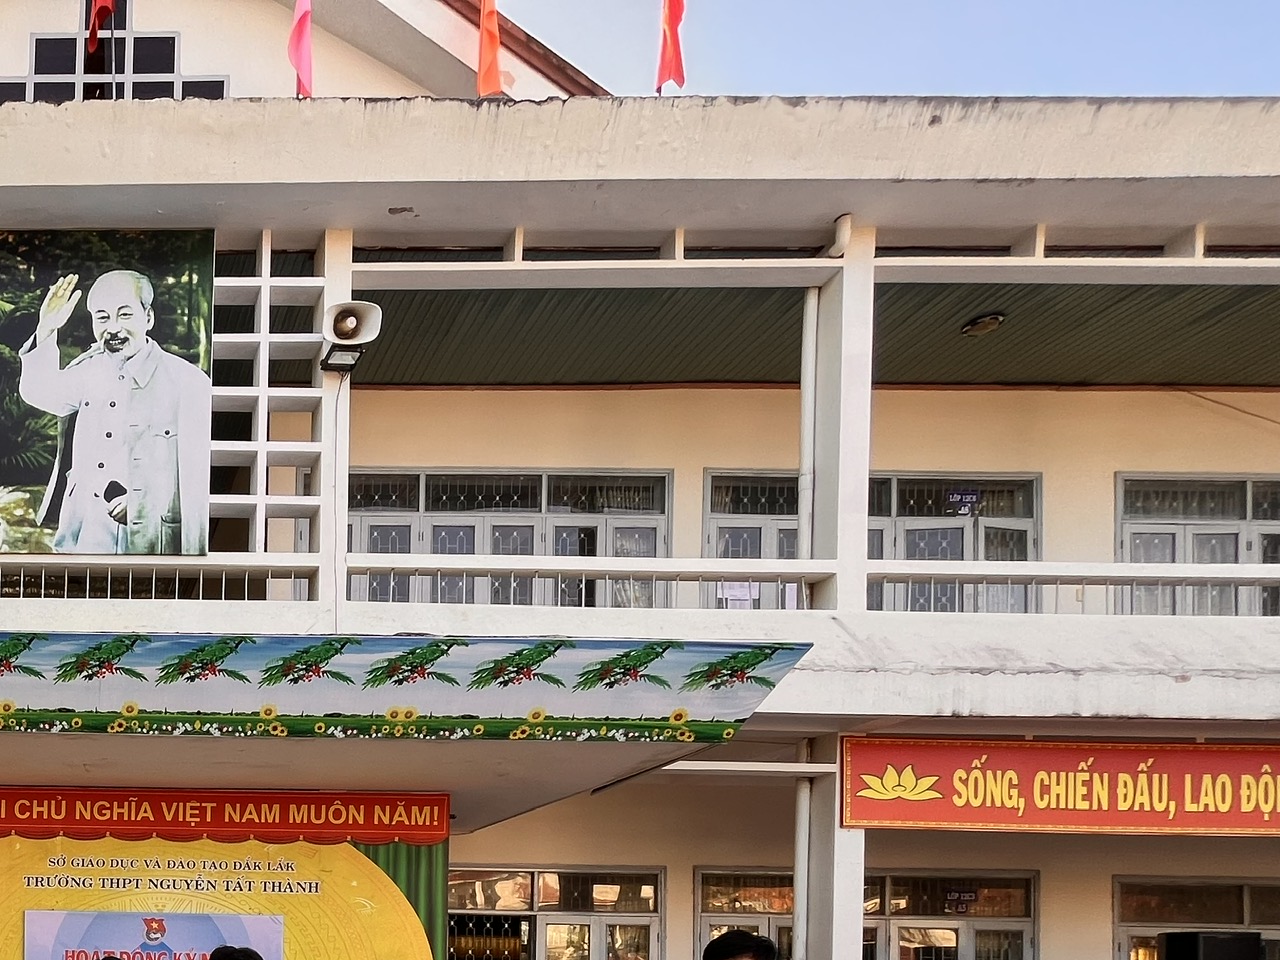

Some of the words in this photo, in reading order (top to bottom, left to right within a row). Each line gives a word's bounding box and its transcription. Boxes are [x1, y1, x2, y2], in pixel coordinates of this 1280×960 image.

[952, 754, 1025, 817] SỐNG,
[1033, 757, 1109, 811] CHIẾN
[1116, 758, 1176, 820] ĐẤU,
[1184, 773, 1233, 813] LAO
[14, 796, 67, 820] CHỦ
[75, 797, 155, 821] NGHĨA
[161, 800, 217, 827] VIỆT
[224, 803, 280, 823] NAM
[289, 800, 365, 825] MUÔN
[373, 801, 439, 826] NĂM!
[48, 854, 67, 868] SỞ
[71, 856, 106, 868] GIÁO
[110, 859, 139, 870] DỤC
[144, 857, 162, 869] VÀ
[167, 857, 196, 870] ĐÀO
[200, 860, 228, 871] TẠO
[233, 856, 263, 871] ĐẮK
[267, 858, 295, 872] LẮK
[23, 874, 94, 889] TRƯỜNG
[99, 878, 143, 889] THPT
[148, 874, 217, 891] NGUYỄN
[222, 876, 256, 892] TẤT
[261, 878, 320, 893] THÀNH
